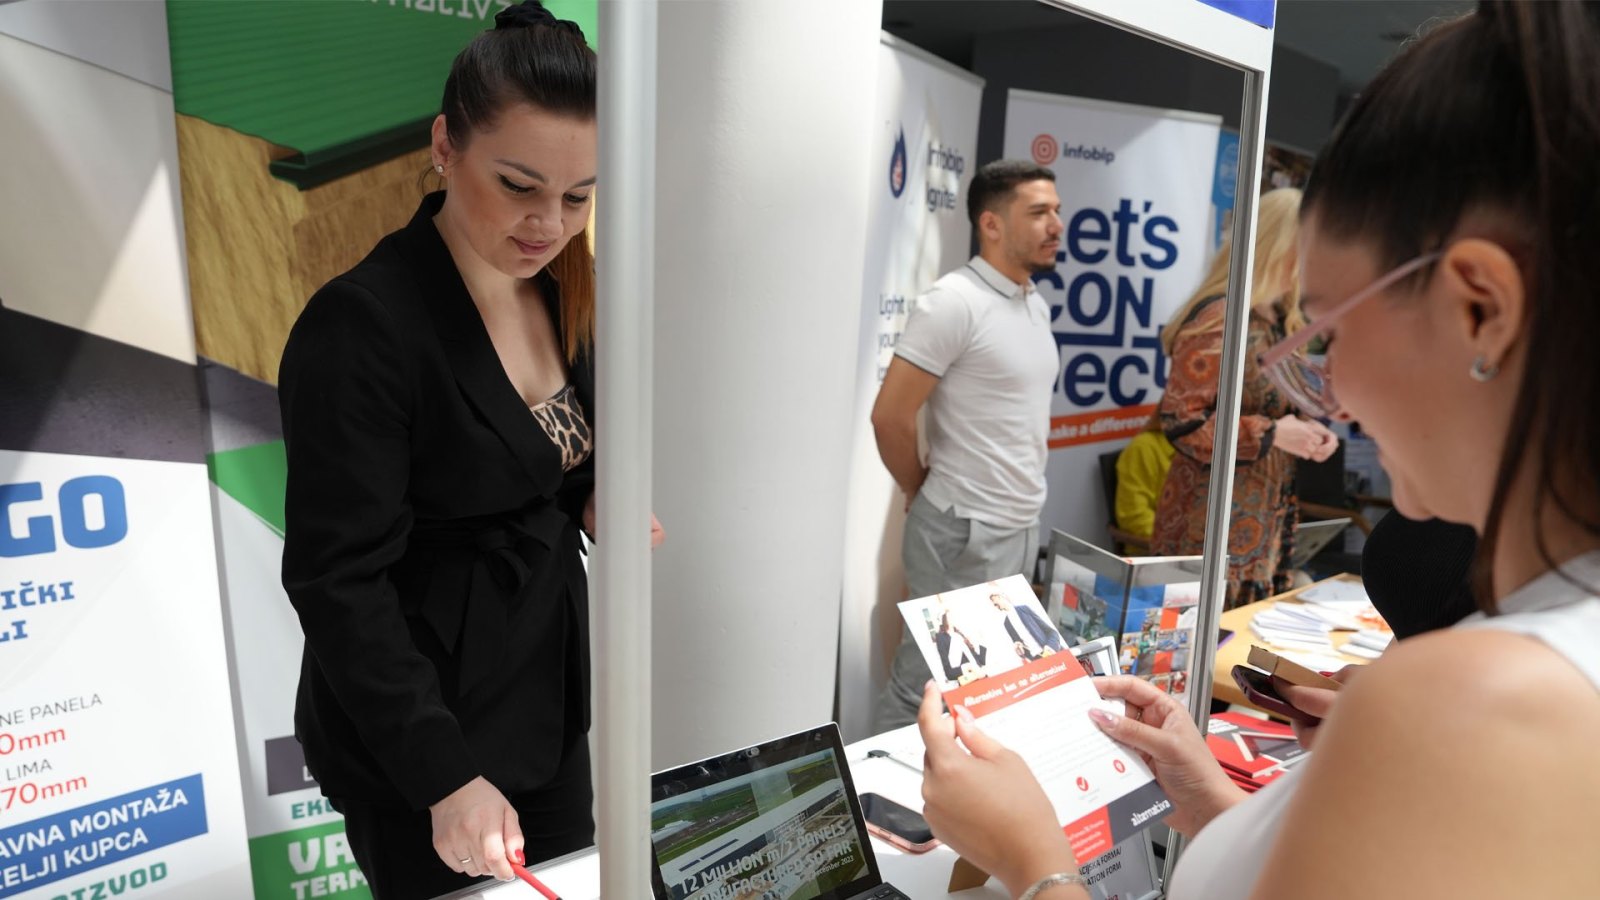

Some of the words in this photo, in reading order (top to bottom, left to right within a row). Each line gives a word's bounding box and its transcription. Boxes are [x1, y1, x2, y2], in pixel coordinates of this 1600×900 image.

[1063, 143, 1115, 165] infobip
[1055, 198, 1179, 270] et's
[30, 693, 102, 720] PANELA
[6, 758, 52, 781] LIMA
[69, 788, 188, 838] MONTAŽA
[1131, 799, 1171, 826] alternativa
[64, 827, 149, 869] KUPCA
[680, 875, 699, 895] 12
[701, 850, 764, 886] MILLION
[797, 820, 847, 848] PANELS
[806, 849, 823, 866] SO
[828, 839, 852, 860] FAR
[841, 855, 854, 866] 2023
[1106, 862, 1122, 877] FORM
